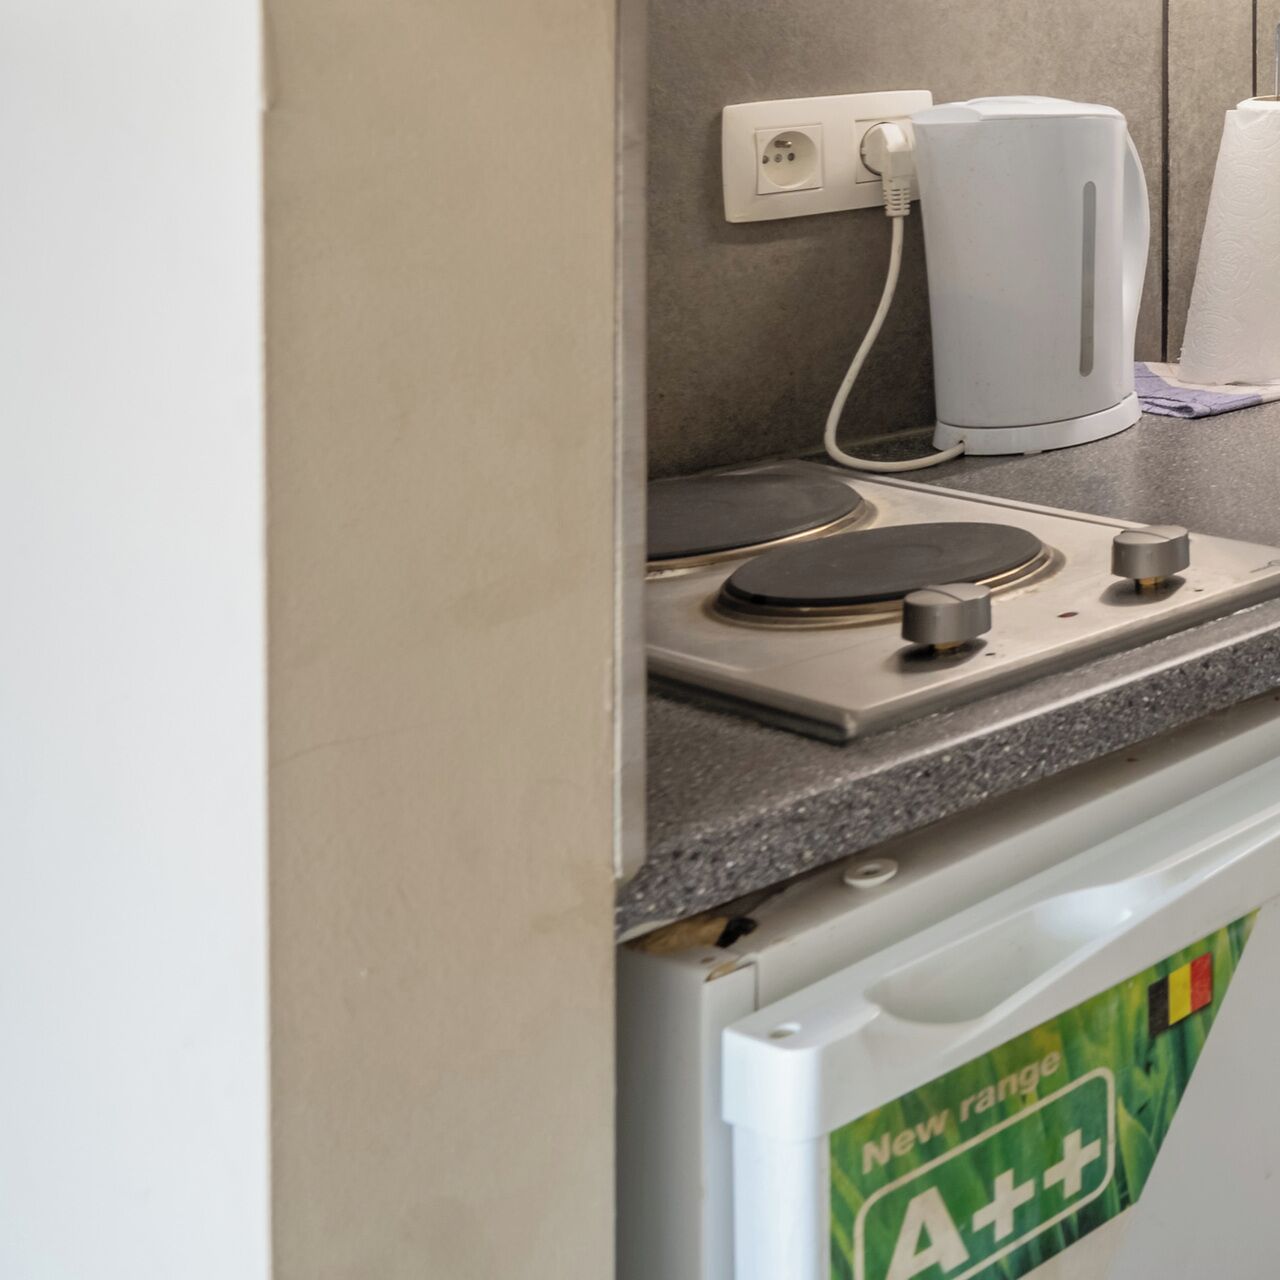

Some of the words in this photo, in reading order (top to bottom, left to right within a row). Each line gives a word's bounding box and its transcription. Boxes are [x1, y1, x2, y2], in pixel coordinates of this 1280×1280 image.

[861, 1108, 949, 1176] New
[959, 1050, 1061, 1123] range
[885, 1128, 1101, 1280] A++
